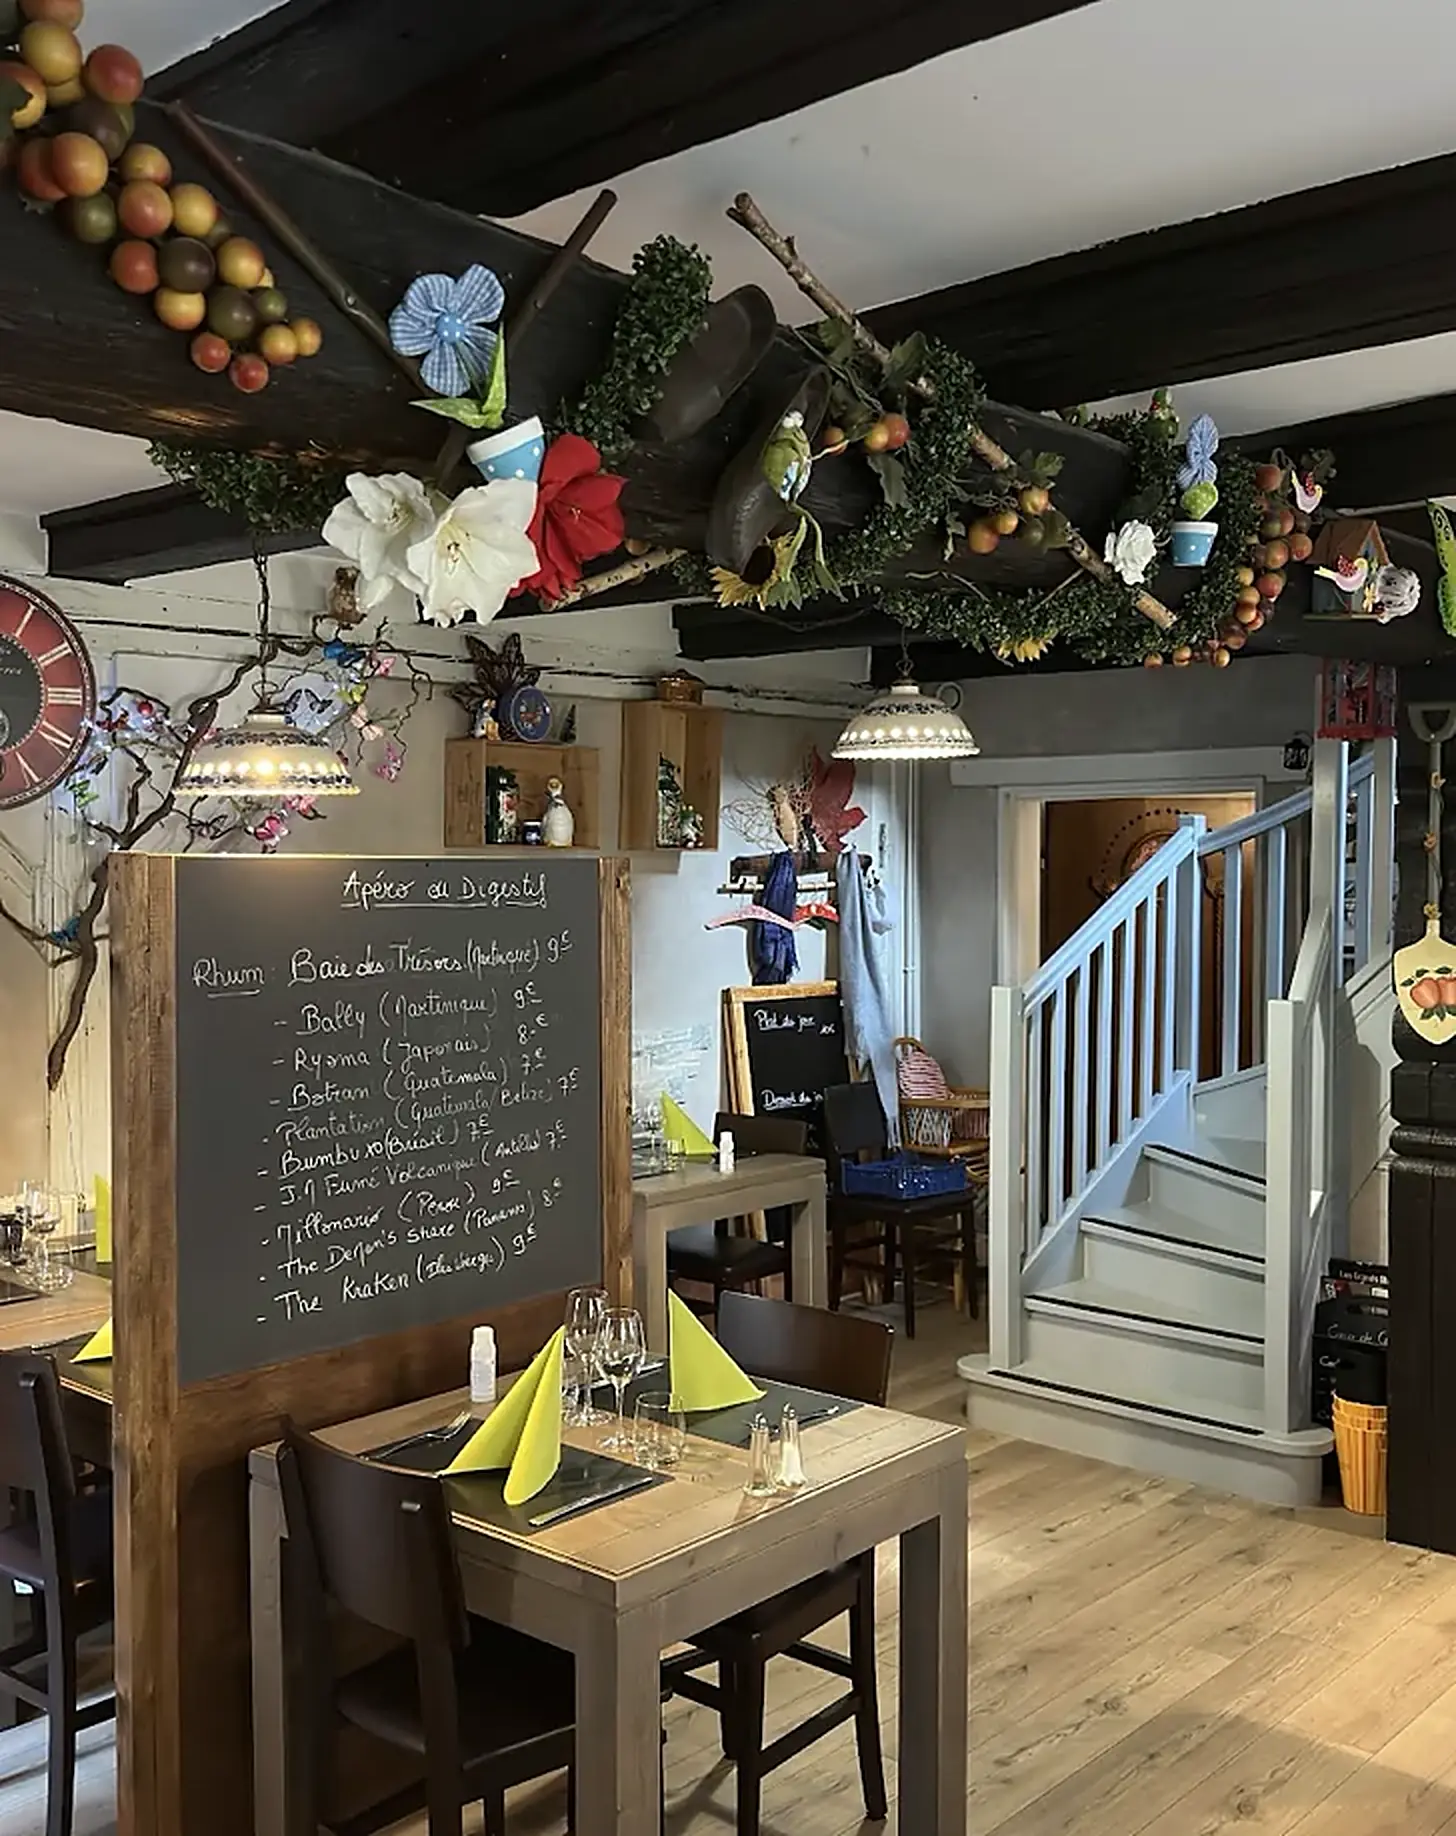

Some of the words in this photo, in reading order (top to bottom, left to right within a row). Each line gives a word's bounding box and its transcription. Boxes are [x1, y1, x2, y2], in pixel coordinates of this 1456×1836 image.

[342, 870, 416, 910] Apéro
[427, 879, 450, 899] ou
[457, 872, 547, 909] Digestif
[277, 1257, 319, 1279] The
[273, 1289, 324, 1321] The
